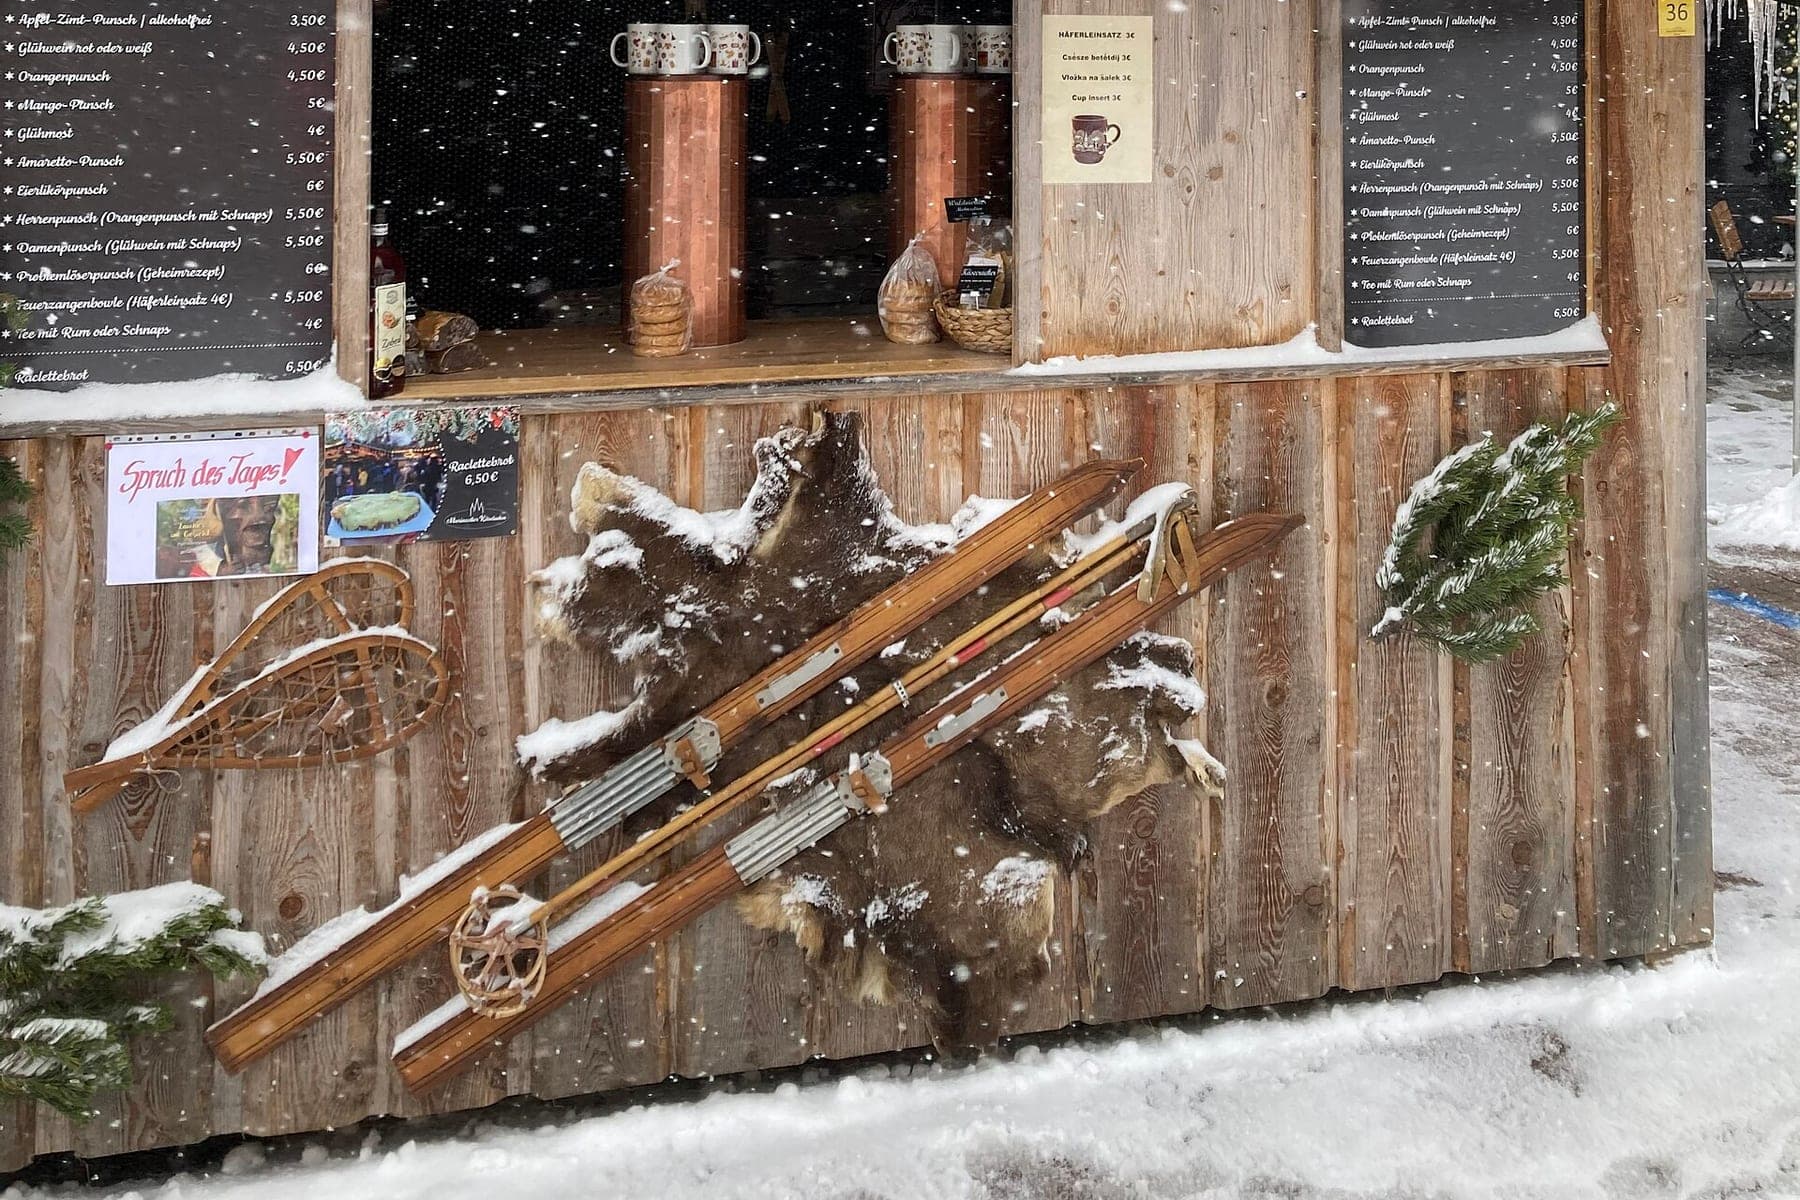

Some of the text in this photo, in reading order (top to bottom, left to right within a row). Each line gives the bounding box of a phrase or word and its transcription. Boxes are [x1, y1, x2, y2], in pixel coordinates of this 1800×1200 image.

[1451, 15, 1496, 27] alkoholfrei
[1552, 14, 1578, 26] 3,50€
[1666, 3, 1688, 21] 36
[18, 13, 138, 29] Apfel-Zimt-Punsch
[148, 13, 212, 30] alkoholfrei
[289, 13, 326, 27] 3,50€
[18, 41, 326, 58] Glühwein rot oder weiß 4,50€
[1358, 38, 1578, 52] Glühwein rot oder weiß 4,50€
[1358, 61, 1578, 76] Orangenpunsch 4,50€
[17, 69, 326, 86] Orangenpunsch 4,50€
[1071, 94, 1087, 102] Cup
[1358, 85, 1578, 101] Mango-Punsch 5€
[17, 97, 326, 114] Mango-Punsch 5€
[1359, 107, 1578, 124] Glühmost 4€
[17, 125, 326, 141] Glühmost 4€
[1359, 132, 1579, 146] Amaretto-Punsch 5,50€
[17, 152, 325, 169] Amaretto-Punsch 5,50€
[1359, 155, 1579, 172] Eierlikörpunsch 6€
[16, 180, 325, 200] Eierlikörpunsch 6€
[1359, 178, 1579, 195] Herrenpunsch (Orangenpunsch mit Schnaps) 5,50€
[15, 207, 324, 228] Herrenpunsch (Orangenpunsch mit Schnaps) 5,50€
[1423, 204, 1466, 219] (Glühwein
[1467, 205, 1482, 216] mit
[1483, 203, 1521, 217] Schnaps)
[1551, 202, 1579, 212] 5,50€
[1446, 227, 1510, 242] (Geheimrezept)
[1566, 225, 1579, 236] 6€
[16, 235, 324, 256] Damenpunsch (Glühwein mit Schnaps) 5,50€
[1361, 248, 1580, 267] Feuerzangenbowle (Häferleinsatz 4€) 5,50€
[16, 263, 324, 284] Problemlöserpunsch (Geheimrezept) 6€
[1361, 272, 1580, 290] Tee mit Rum oder Schnaps 4€
[16, 290, 323, 313] Feuerzangenbowle (Häferleinsatz 4€) 5,50€
[1361, 306, 1580, 327] Raclettebrot 6,50€
[16, 317, 323, 340] Tee mit Rum oder Schnaps 4€
[15, 359, 322, 384] Raclettebrot 6,50€
[448, 454, 515, 473] Raclettebrot
[119, 447, 305, 504] Spruch des Tages!
[464, 471, 499, 486] 6,50€
